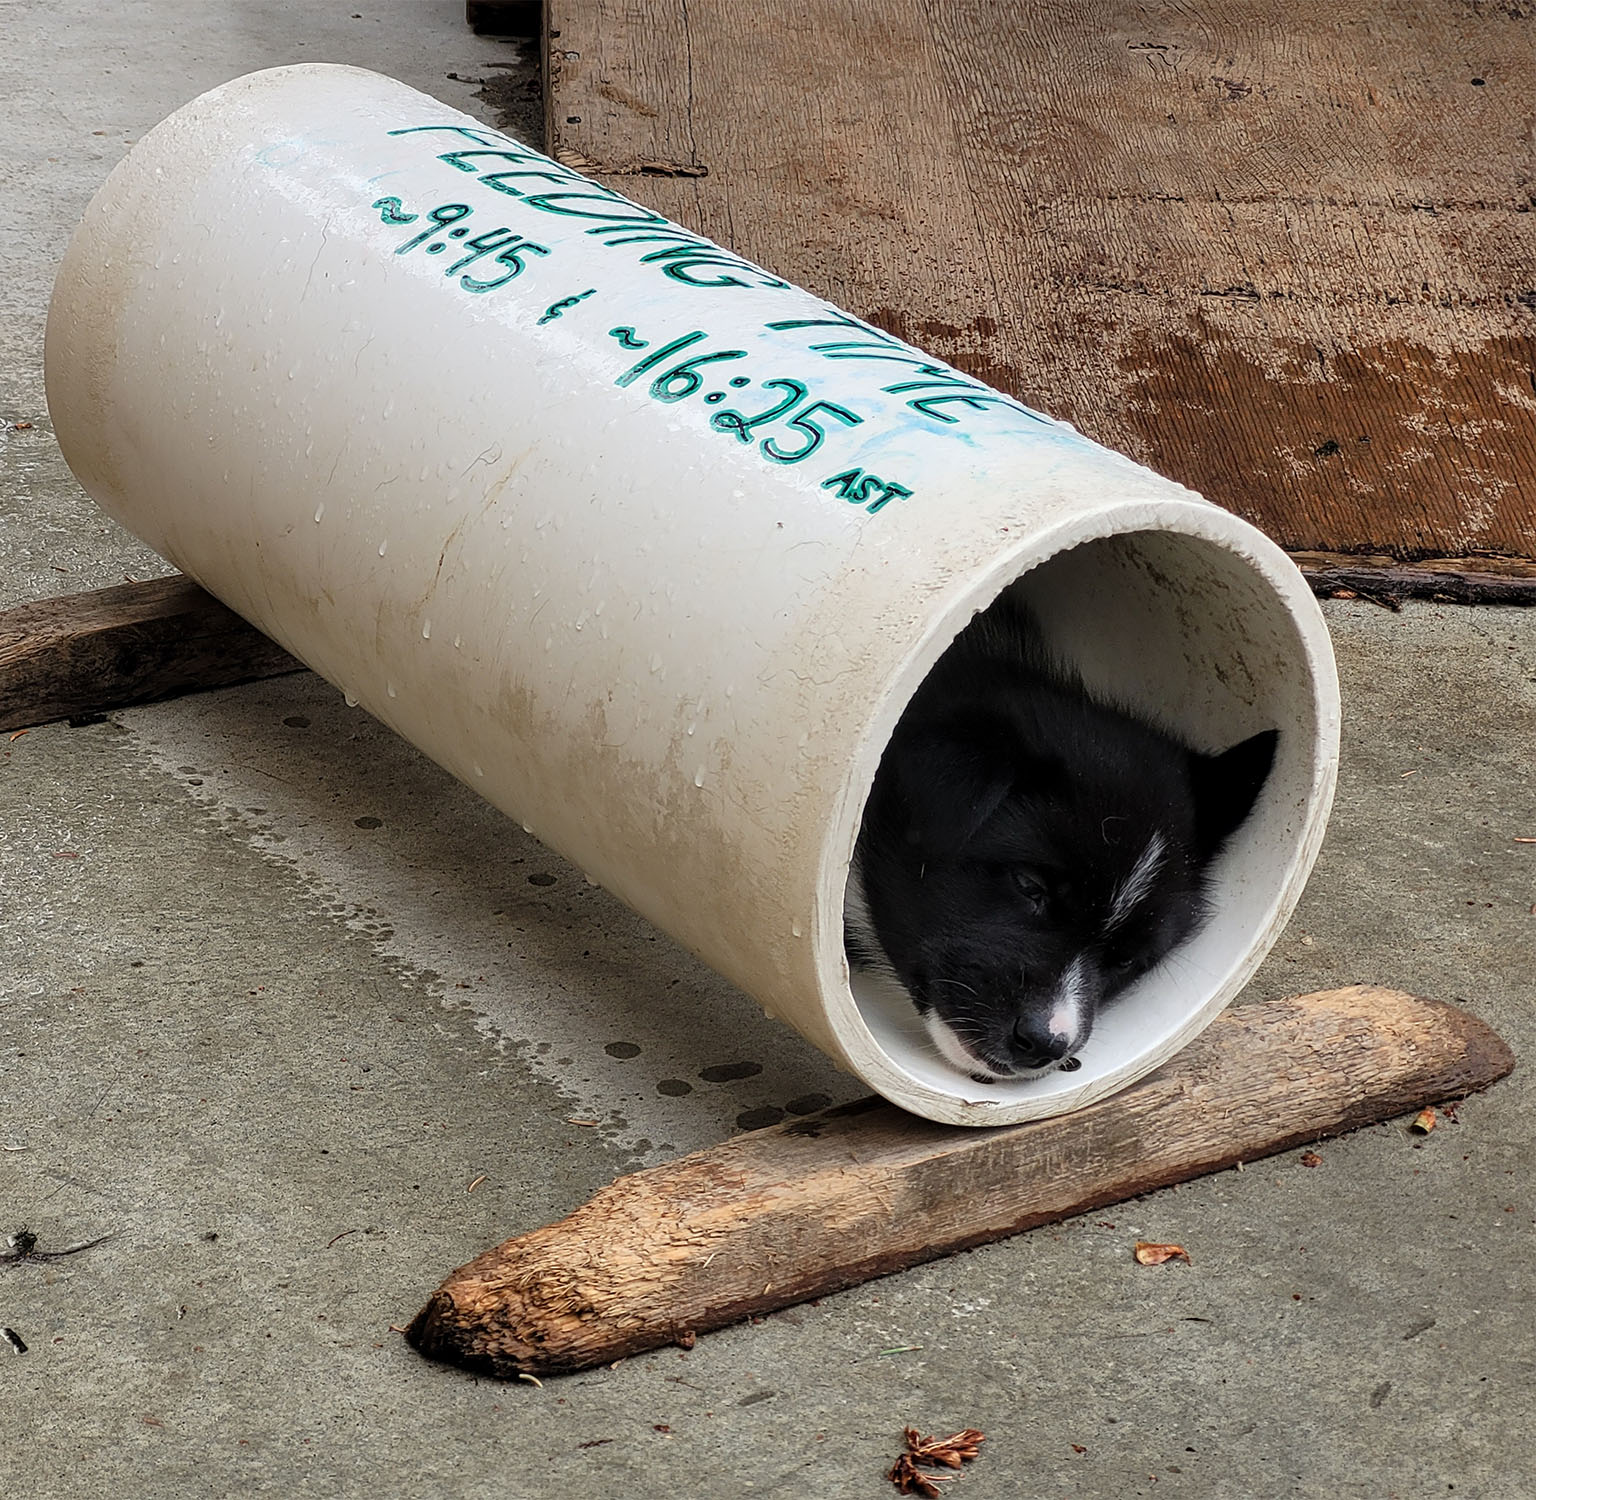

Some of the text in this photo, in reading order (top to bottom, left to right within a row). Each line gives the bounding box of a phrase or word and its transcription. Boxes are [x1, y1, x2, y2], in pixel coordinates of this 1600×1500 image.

[386, 125, 1055, 424] FEEDING TIME
[821, 467, 914, 515] AST
